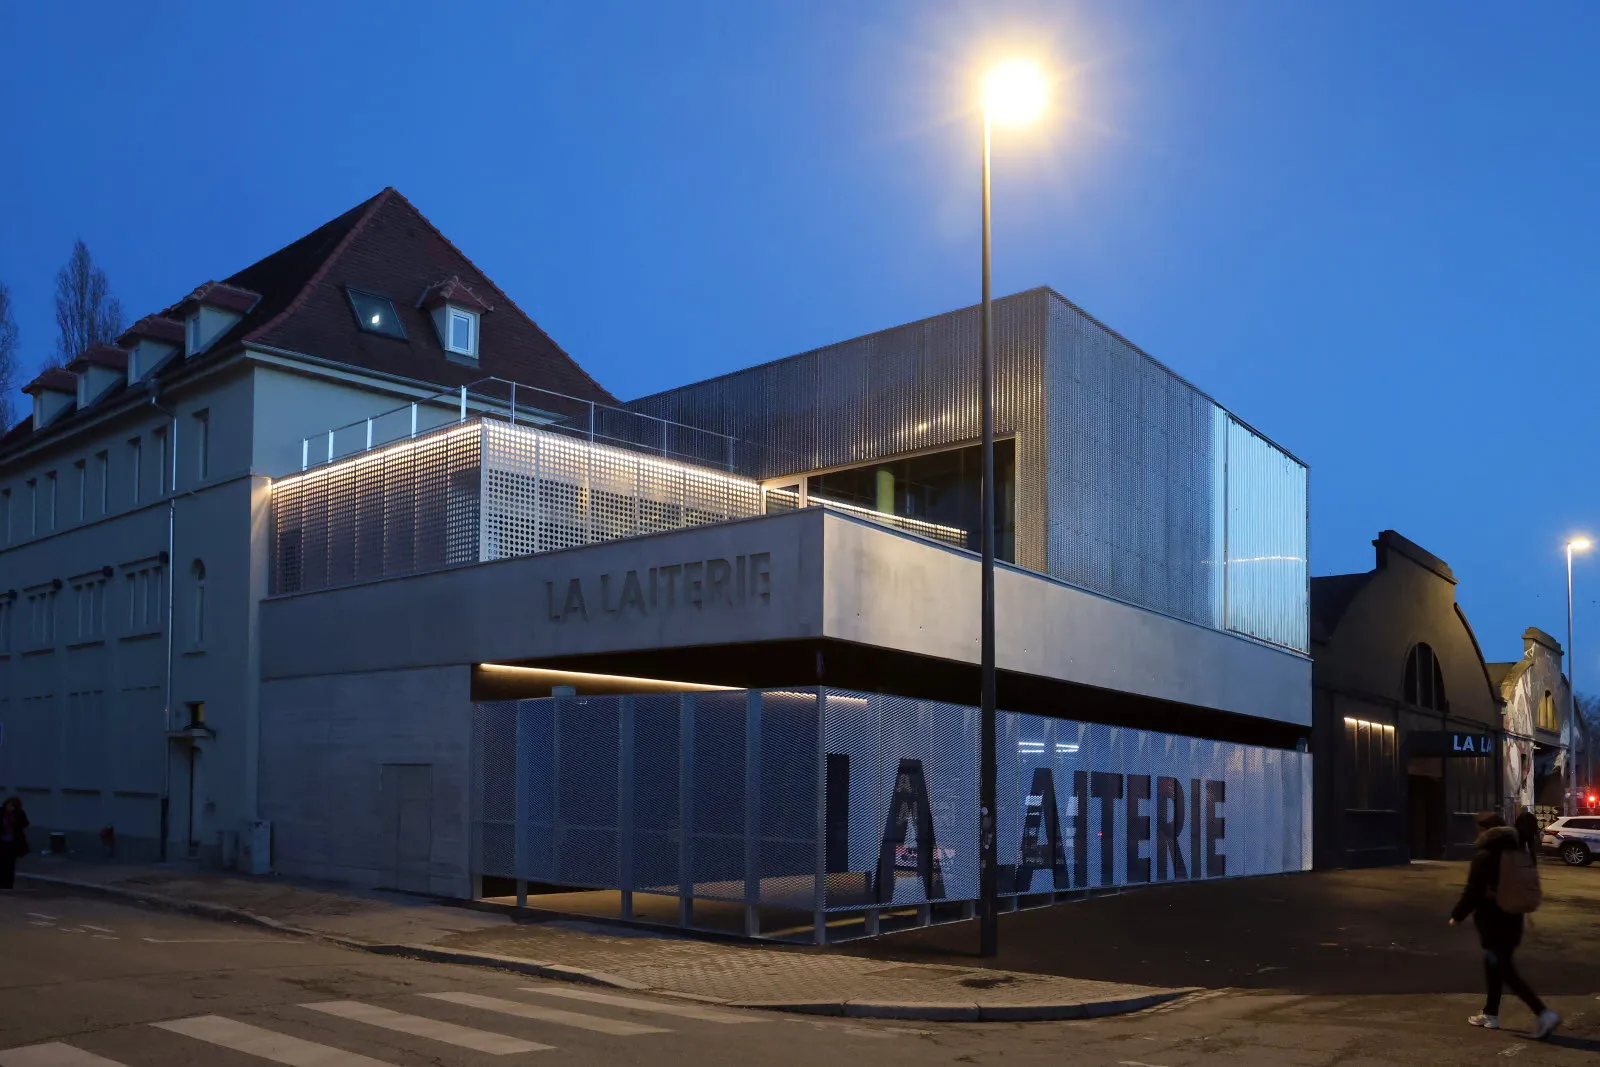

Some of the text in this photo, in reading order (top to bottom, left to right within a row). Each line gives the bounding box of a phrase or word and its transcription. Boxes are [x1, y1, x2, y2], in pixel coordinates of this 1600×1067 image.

[546, 552, 771, 623] LA LAITERIE
[1453, 735, 1475, 751] LA
[826, 753, 946, 907] LA
